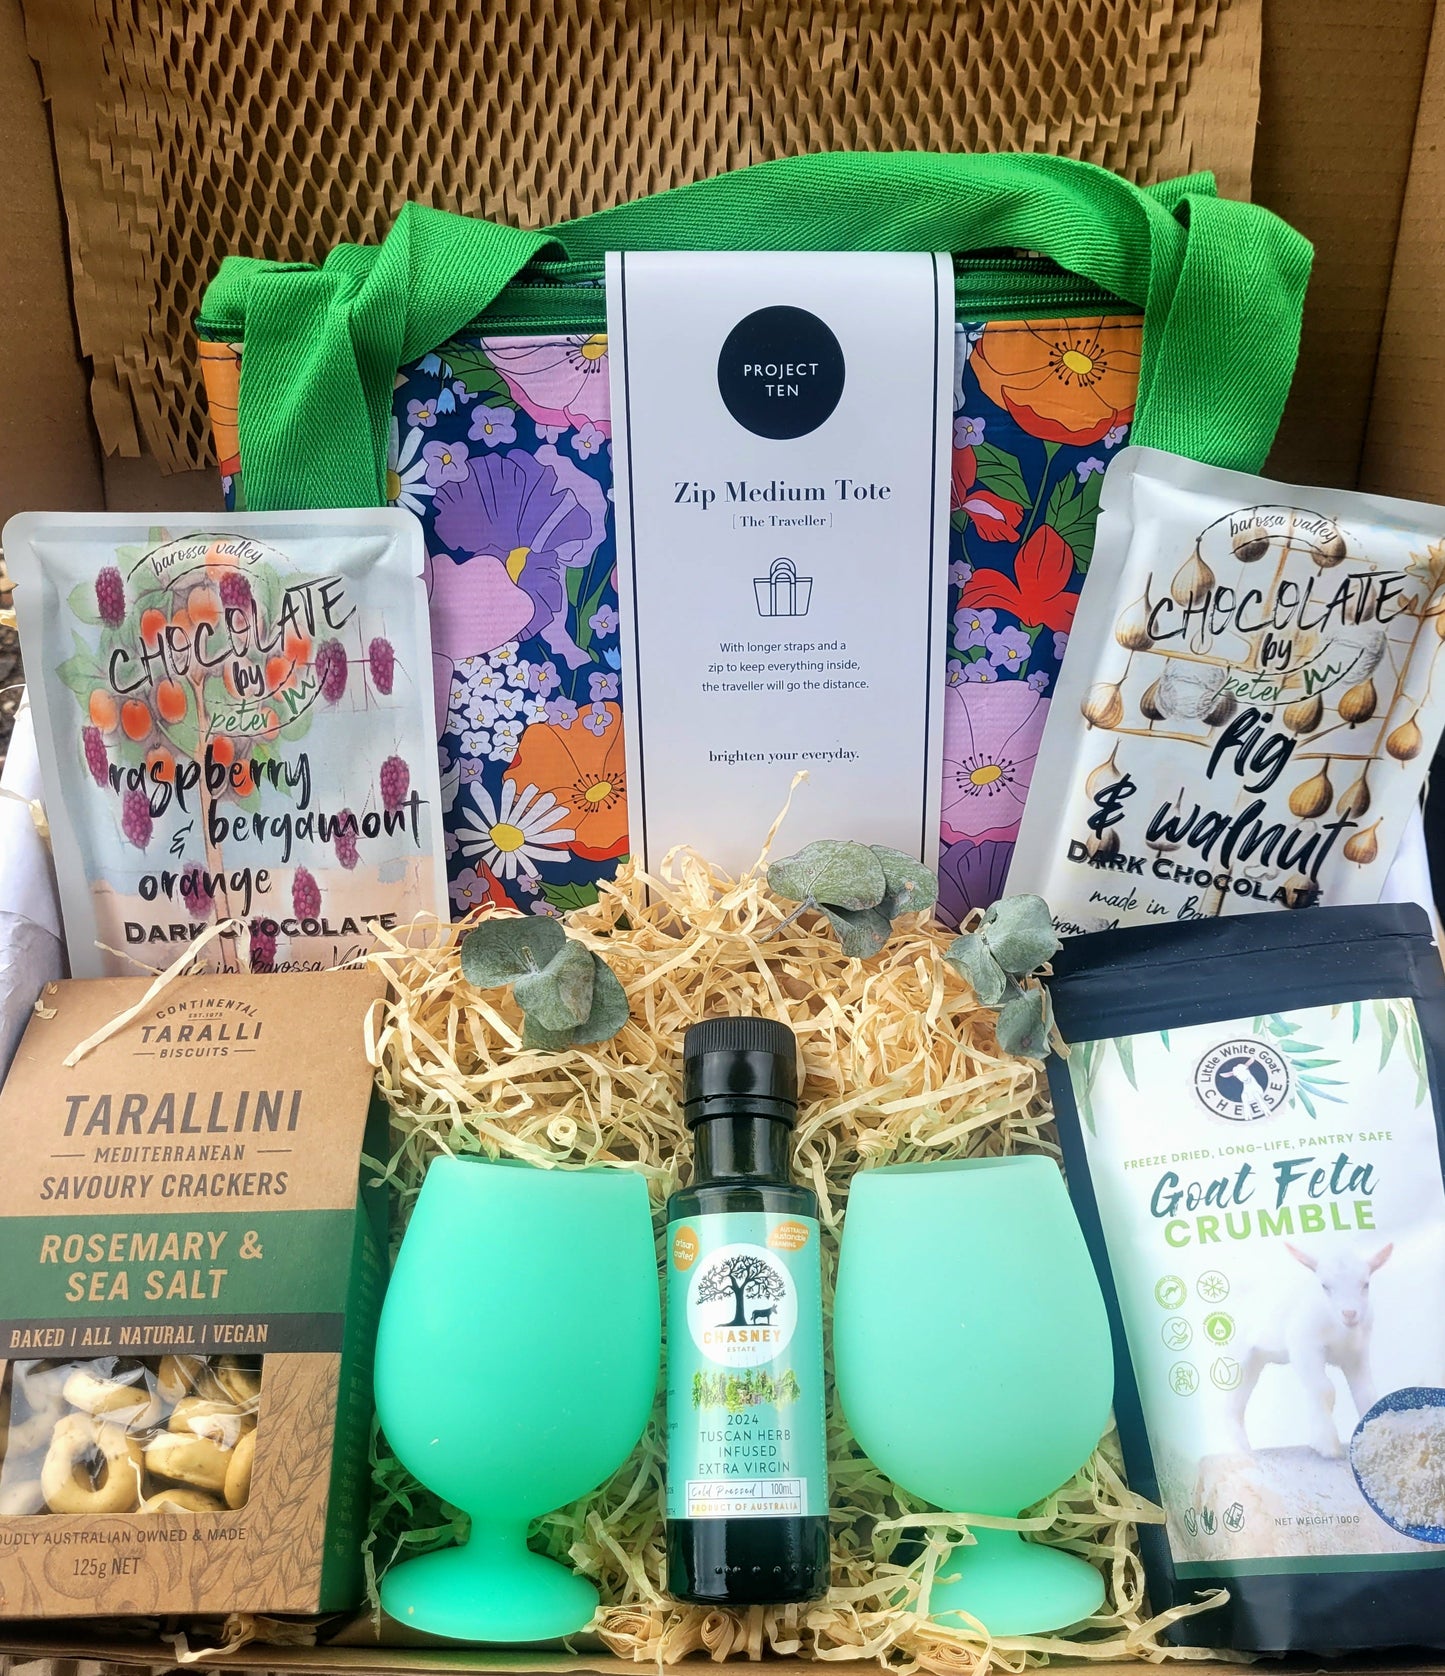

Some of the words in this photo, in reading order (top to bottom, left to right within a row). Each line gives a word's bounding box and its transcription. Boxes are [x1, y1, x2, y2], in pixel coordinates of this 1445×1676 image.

[744, 362, 820, 379] PROJECT
[764, 383, 800, 398] TEN
[674, 482, 716, 511] Zip
[724, 480, 826, 503] Medium
[834, 479, 891, 501] Tote
[1229, 514, 1286, 537] barossa
[1292, 517, 1338, 545] valley
[151, 544, 209, 577] barossa
[216, 541, 264, 565] valley
[1147, 570, 1409, 643] CHOCOLATE
[109, 576, 357, 696] CHOCOLATE
[720, 642, 744, 653] With
[747, 642, 781, 654] longer
[783, 641, 815, 653] straps
[817, 640, 838, 651] and
[840, 642, 846, 650] a
[1260, 633, 1293, 671] by
[233, 659, 266, 696] by
[708, 662, 724, 675] zip
[726, 663, 737, 672] to
[740, 661, 765, 674] keep
[767, 660, 824, 673] everything
[826, 659, 860, 671] inside,
[702, 681, 719, 692] the
[722, 680, 764, 692] traveller
[766, 680, 784, 690] will
[786, 682, 801, 692] go
[803, 680, 821, 689] the
[822, 679, 869, 690] distance.
[1211, 669, 1285, 704] peter
[206, 702, 273, 741] peter
[709, 750, 765, 765] brighten
[768, 752, 799, 764] your
[801, 748, 860, 763] everyday.
[1206, 706, 1299, 793] fig
[108, 743, 312, 818] raspberry
[169, 819, 193, 860] &
[208, 789, 431, 862] bergamont
[1087, 773, 1137, 839] &
[1145, 797, 1359, 884] walnut
[1067, 838, 1148, 876] DARK
[1152, 857, 1324, 907] CHOCOLATE
[138, 862, 273, 916] orange
[1089, 887, 1138, 912] made
[1146, 898, 1170, 915] in
[123, 921, 208, 944] DARK
[216, 961, 240, 974] in
[249, 946, 325, 975] Barossa
[155, 998, 258, 1019] CONTINENTAL
[141, 1021, 262, 1043] TARALLI
[159, 1046, 229, 1058] BISCUITS
[1200, 1056, 1220, 1083] Little
[1219, 1045, 1256, 1057] White
[1258, 1051, 1281, 1074] Goat
[63, 1089, 303, 1137] TARALLINI
[1204, 1082, 1282, 1116] CHEESE
[93, 1144, 246, 1164] MEDITERRANEAN
[1123, 1154, 1168, 1171] FREEZE
[1171, 1148, 1216, 1164] DRIED,
[1218, 1139, 1295, 1156] LONG-LIFE,
[1298, 1132, 1354, 1147] PANTRY
[1359, 1130, 1393, 1142] SAFE
[39, 1174, 153, 1201] SAVOURY
[161, 1171, 289, 1198] CRACKERS
[1150, 1162, 1257, 1218] Goat
[1272, 1151, 1381, 1210] Feta
[1164, 1200, 1377, 1249] CRUMBLE
[39, 1231, 228, 1264] ROSEMARY
[239, 1230, 264, 1260] &
[65, 1271, 129, 1302] SEA
[144, 1269, 229, 1300] SALT
[9, 1328, 65, 1350] BAKED
[81, 1327, 112, 1347] ALL
[118, 1325, 196, 1346] NATURAL
[213, 1324, 269, 1343] VEGAN
[703, 1329, 781, 1345] CHASNEY
[727, 1414, 759, 1426] 2024
[700, 1430, 752, 1443] TUSCAN
[757, 1429, 791, 1441] HERB
[719, 1445, 777, 1458] INFUSED
[699, 1463, 739, 1475] EXTRA
[745, 1461, 790, 1474] VIRGIN
[691, 1483, 711, 1497] Cold
[716, 1483, 757, 1497] Pressed
[691, 1503, 731, 1513] PRODUCT
[734, 1503, 748, 1511] OF
[751, 1502, 798, 1511] AUSTRALIA
[1274, 1517, 1292, 1526] NET
[1295, 1516, 1334, 1525] WEIGHT
[0, 1532, 40, 1546] UDLY
[43, 1531, 133, 1545] AUSTRALIAN
[136, 1529, 188, 1544] OWNED
[192, 1529, 202, 1541] &
[207, 1527, 247, 1541] MADE
[72, 1558, 107, 1579] 125g
[111, 1557, 141, 1576] NET
